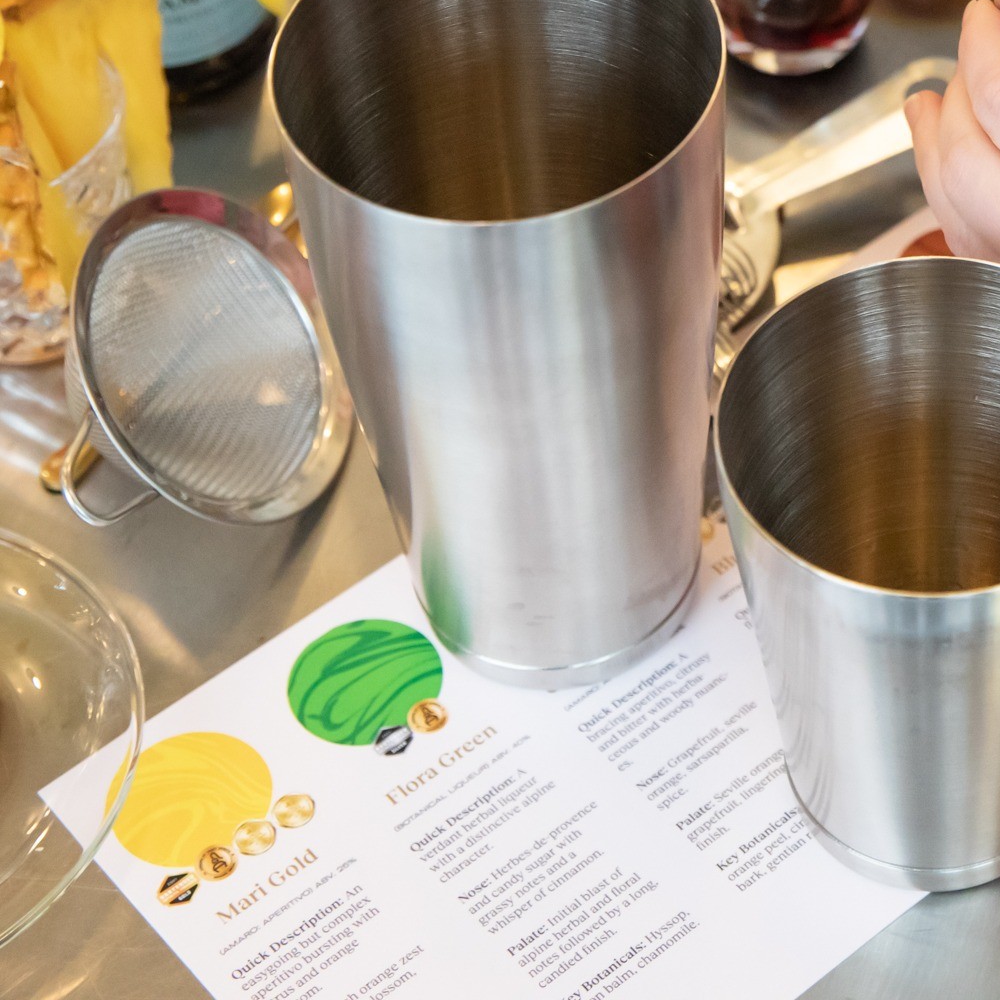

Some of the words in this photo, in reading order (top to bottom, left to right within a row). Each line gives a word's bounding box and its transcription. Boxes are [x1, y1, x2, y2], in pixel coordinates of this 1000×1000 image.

[578, 708, 612, 732] Quick
[611, 661, 678, 708] Description:
[586, 713, 629, 743] bracing
[675, 653, 710, 680] citrusy
[598, 734, 619, 752] and
[617, 714, 648, 737] bitter
[648, 697, 673, 715] with
[608, 738, 639, 762] ceous
[639, 721, 660, 739] and
[659, 698, 694, 723] woody
[385, 768, 438, 805] Flora
[438, 727, 497, 767] Green
[636, 767, 668, 790] Nose:
[410, 826, 446, 852] Quick
[445, 777, 516, 827] Description:
[419, 831, 463, 861] verdant
[461, 804, 499, 832] herbal
[497, 777, 536, 807] liqueur
[429, 853, 456, 872] with
[465, 806, 521, 847] distinctive
[522, 781, 556, 807] alpine
[676, 801, 715, 830] Palate:
[713, 775, 749, 802] Seville
[216, 883, 267, 923] Mari
[268, 848, 318, 887] Gold
[440, 844, 493, 883] character.
[469, 895, 491, 914] and
[491, 871, 524, 897] candy
[525, 849, 555, 873] sugar
[556, 830, 582, 849] with
[716, 854, 738, 871] Key
[728, 853, 764, 881] orange
[766, 839, 806, 872] gentian
[458, 879, 491, 904] Nose:
[479, 896, 513, 927] grassy
[515, 874, 545, 898] notes
[546, 856, 568, 875] and
[488, 900, 532, 934] whisper
[547, 851, 604, 892] cinnamon.
[507, 925, 548, 956] Palate:
[547, 898, 582, 926] Initial
[580, 879, 610, 901] blast
[518, 939, 553, 967] alpine
[552, 911, 590, 940] herbal
[590, 894, 612, 913] and
[611, 873, 641, 897] floral
[232, 952, 270, 979] Quick
[269, 899, 344, 952] Description:
[242, 947, 301, 991] easygoing
[298, 932, 321, 949] but
[322, 897, 371, 933] complex
[296, 967, 319, 987] and
[320, 940, 359, 970] orange
[301, 927, 354, 964] bursting
[352, 908, 380, 927] with
[528, 953, 560, 978] notes
[559, 916, 607, 954] followed
[539, 952, 583, 988] candied
[582, 930, 617, 955] finish.
[359, 964, 399, 994] orange
[399, 946, 424, 965] zest
[568, 990, 581, 1000] ey
[581, 942, 646, 991] Botanicals:
